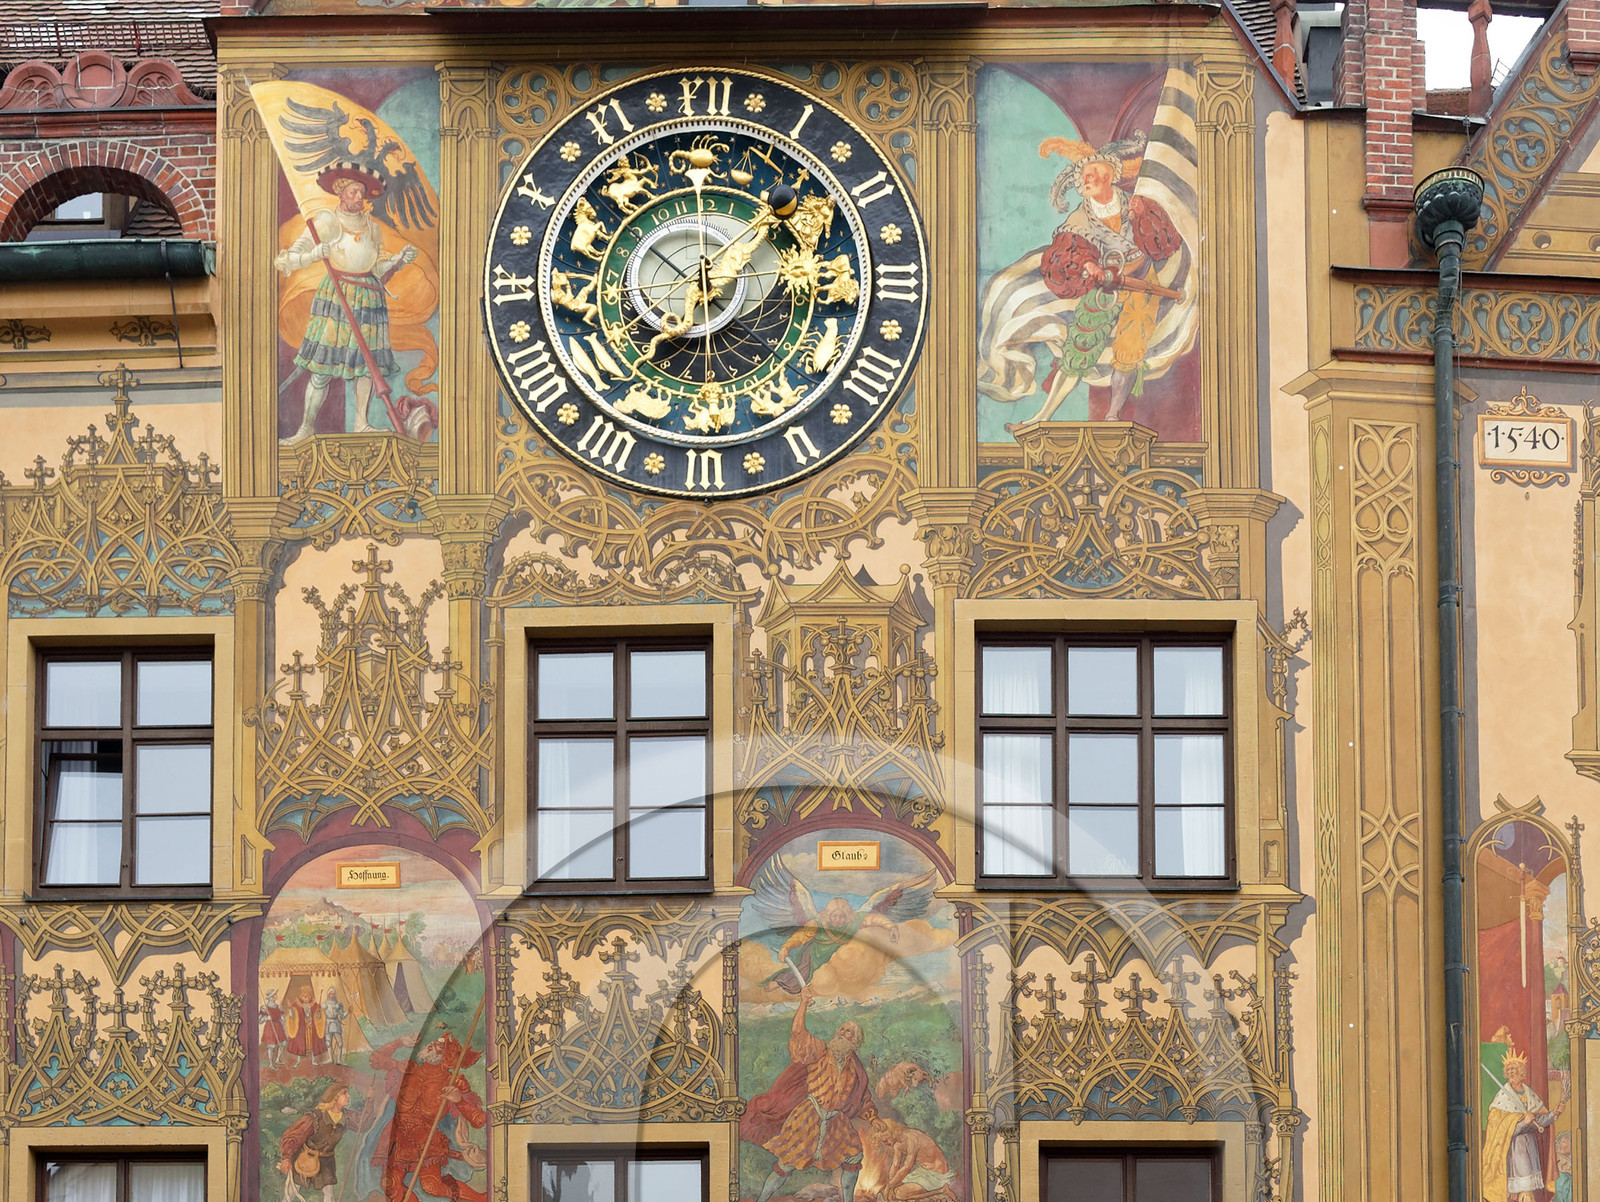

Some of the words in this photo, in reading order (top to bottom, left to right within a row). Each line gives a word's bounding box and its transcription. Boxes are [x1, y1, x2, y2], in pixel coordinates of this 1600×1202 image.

[677, 76, 733, 116] XII
[585, 97, 635, 145] XI
[789, 104, 815, 140] I
[516, 172, 556, 211] X
[851, 170, 895, 209] II
[650, 208, 670, 226] 10
[492, 264, 535, 306] IX
[875, 261, 919, 303] III
